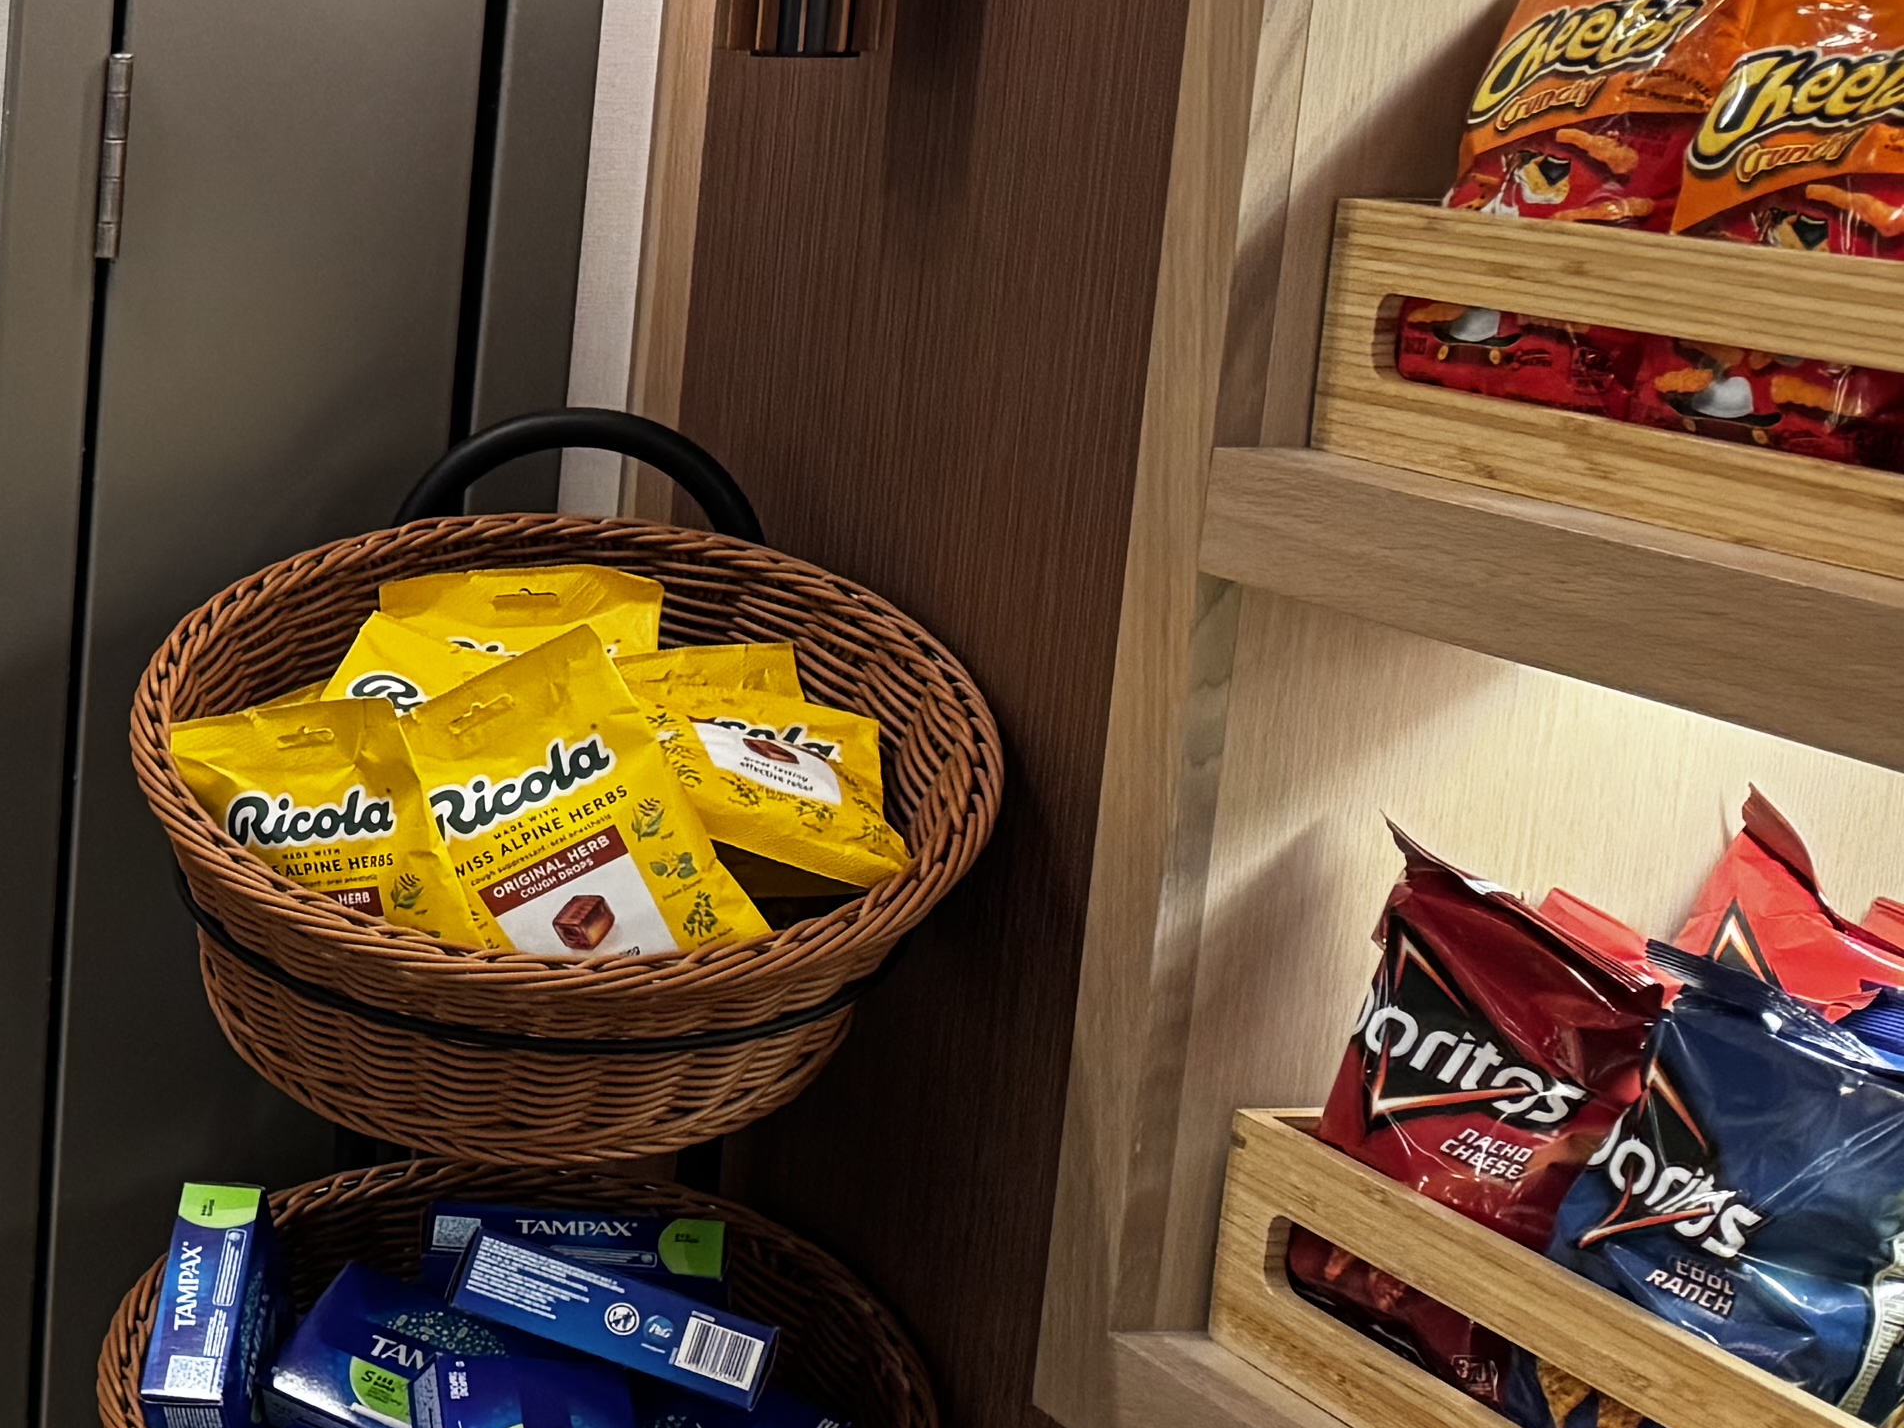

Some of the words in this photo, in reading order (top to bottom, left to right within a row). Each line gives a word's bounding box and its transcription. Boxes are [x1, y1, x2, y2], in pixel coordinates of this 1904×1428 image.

[431, 736, 609, 836] Ricola
[228, 791, 391, 847] Ricola
[497, 810, 564, 861] ALPINE
[569, 786, 627, 825] HERBS
[492, 852, 563, 898] ORIGINAL
[568, 834, 611, 861] HERB
[519, 872, 556, 899] COUGH
[560, 858, 594, 881] DROPS
[516, 1218, 632, 1237] TAMPAX
[173, 1244, 202, 1331] TAMPAX
[1645, 1268, 1735, 1316] RANCH
